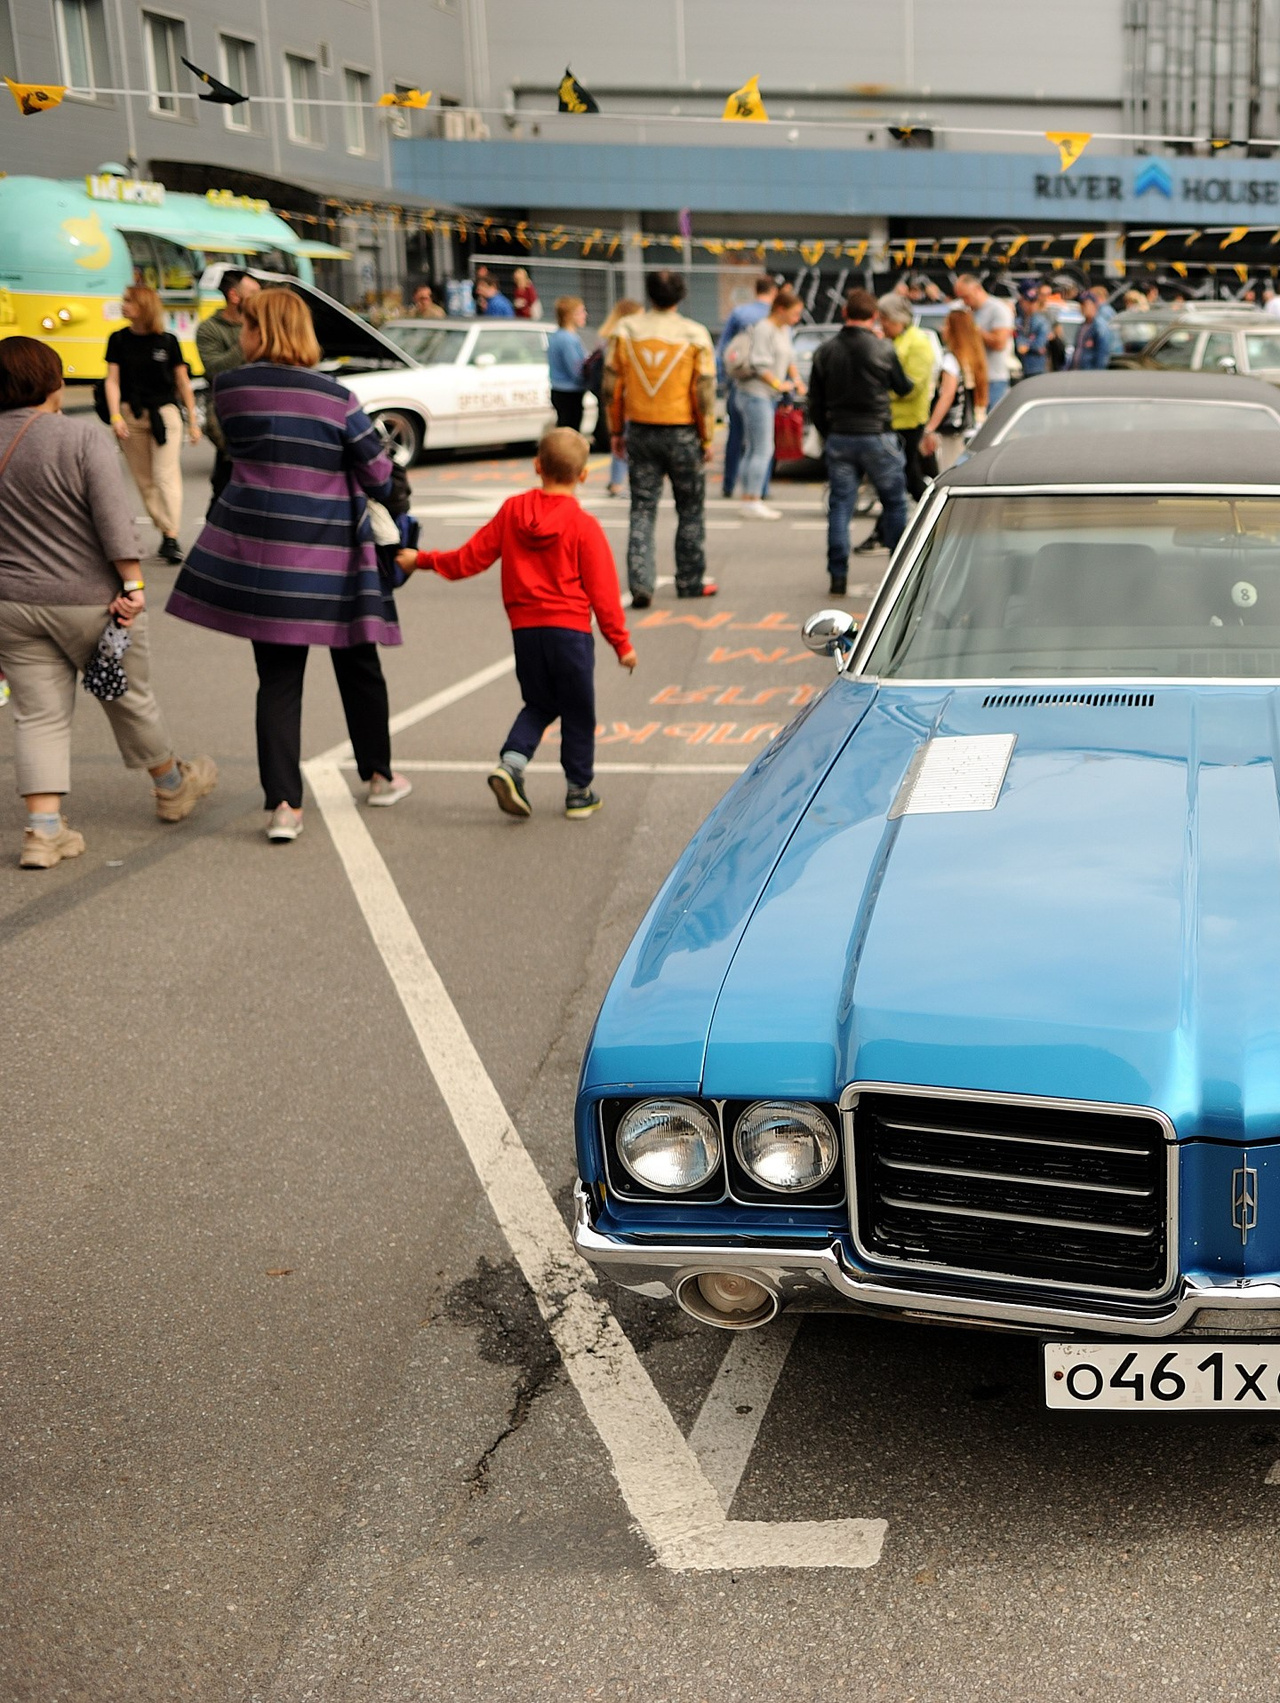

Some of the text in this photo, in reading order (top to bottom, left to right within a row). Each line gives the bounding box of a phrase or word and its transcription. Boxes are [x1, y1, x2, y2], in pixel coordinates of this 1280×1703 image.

[1034, 174, 1280, 204] RIVER HOUSE
[1240, 588, 1251, 601] 8
